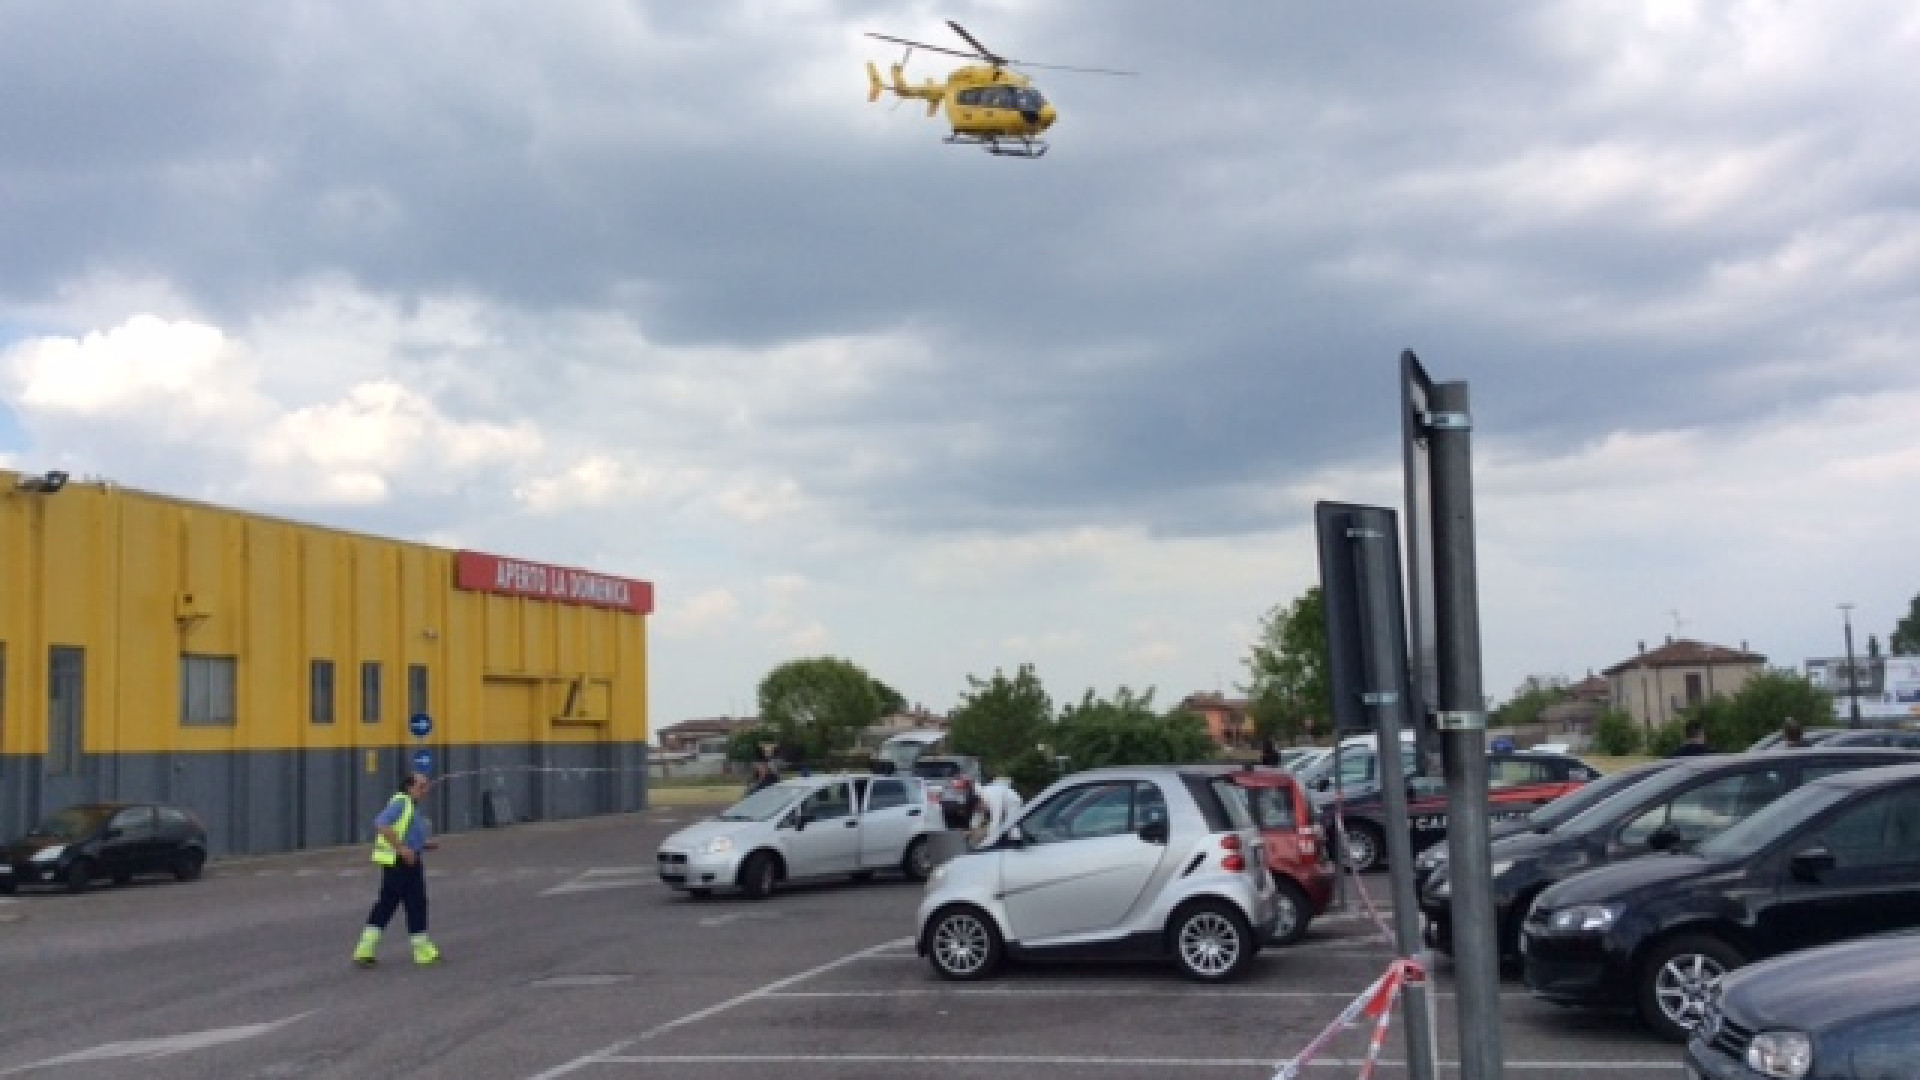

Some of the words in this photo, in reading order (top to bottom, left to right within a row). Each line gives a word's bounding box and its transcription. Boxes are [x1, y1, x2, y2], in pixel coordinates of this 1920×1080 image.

[496, 560, 546, 594] APERTO
[551, 569, 566, 597] LA
[570, 573, 630, 604] DOMENICA
